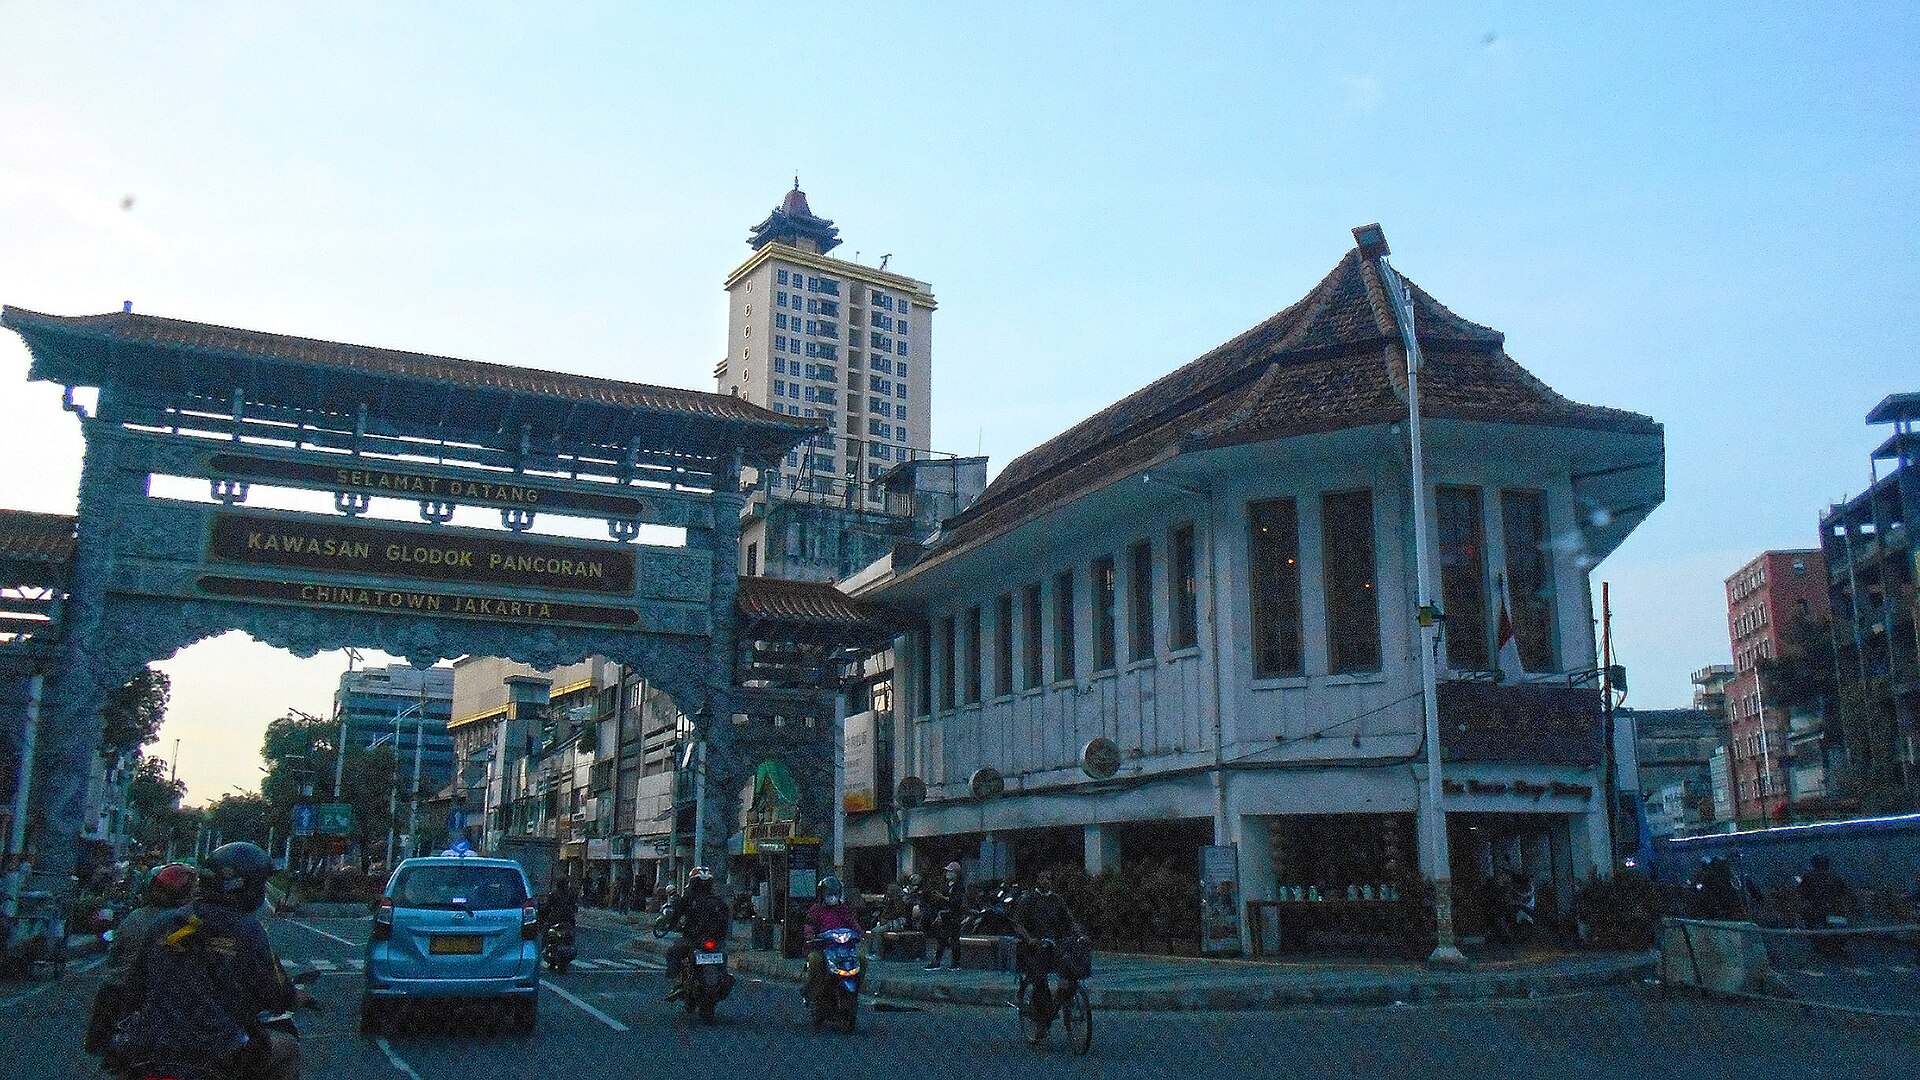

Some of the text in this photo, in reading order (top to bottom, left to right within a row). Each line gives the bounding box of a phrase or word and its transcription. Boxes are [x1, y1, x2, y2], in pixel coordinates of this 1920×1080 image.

[337, 470, 539, 502] SELAMAT DATANG
[248, 532, 603, 578] KAWASAN GLODOK PANCORAN
[301, 586, 551, 618] CHINATOWN JAKARTA
